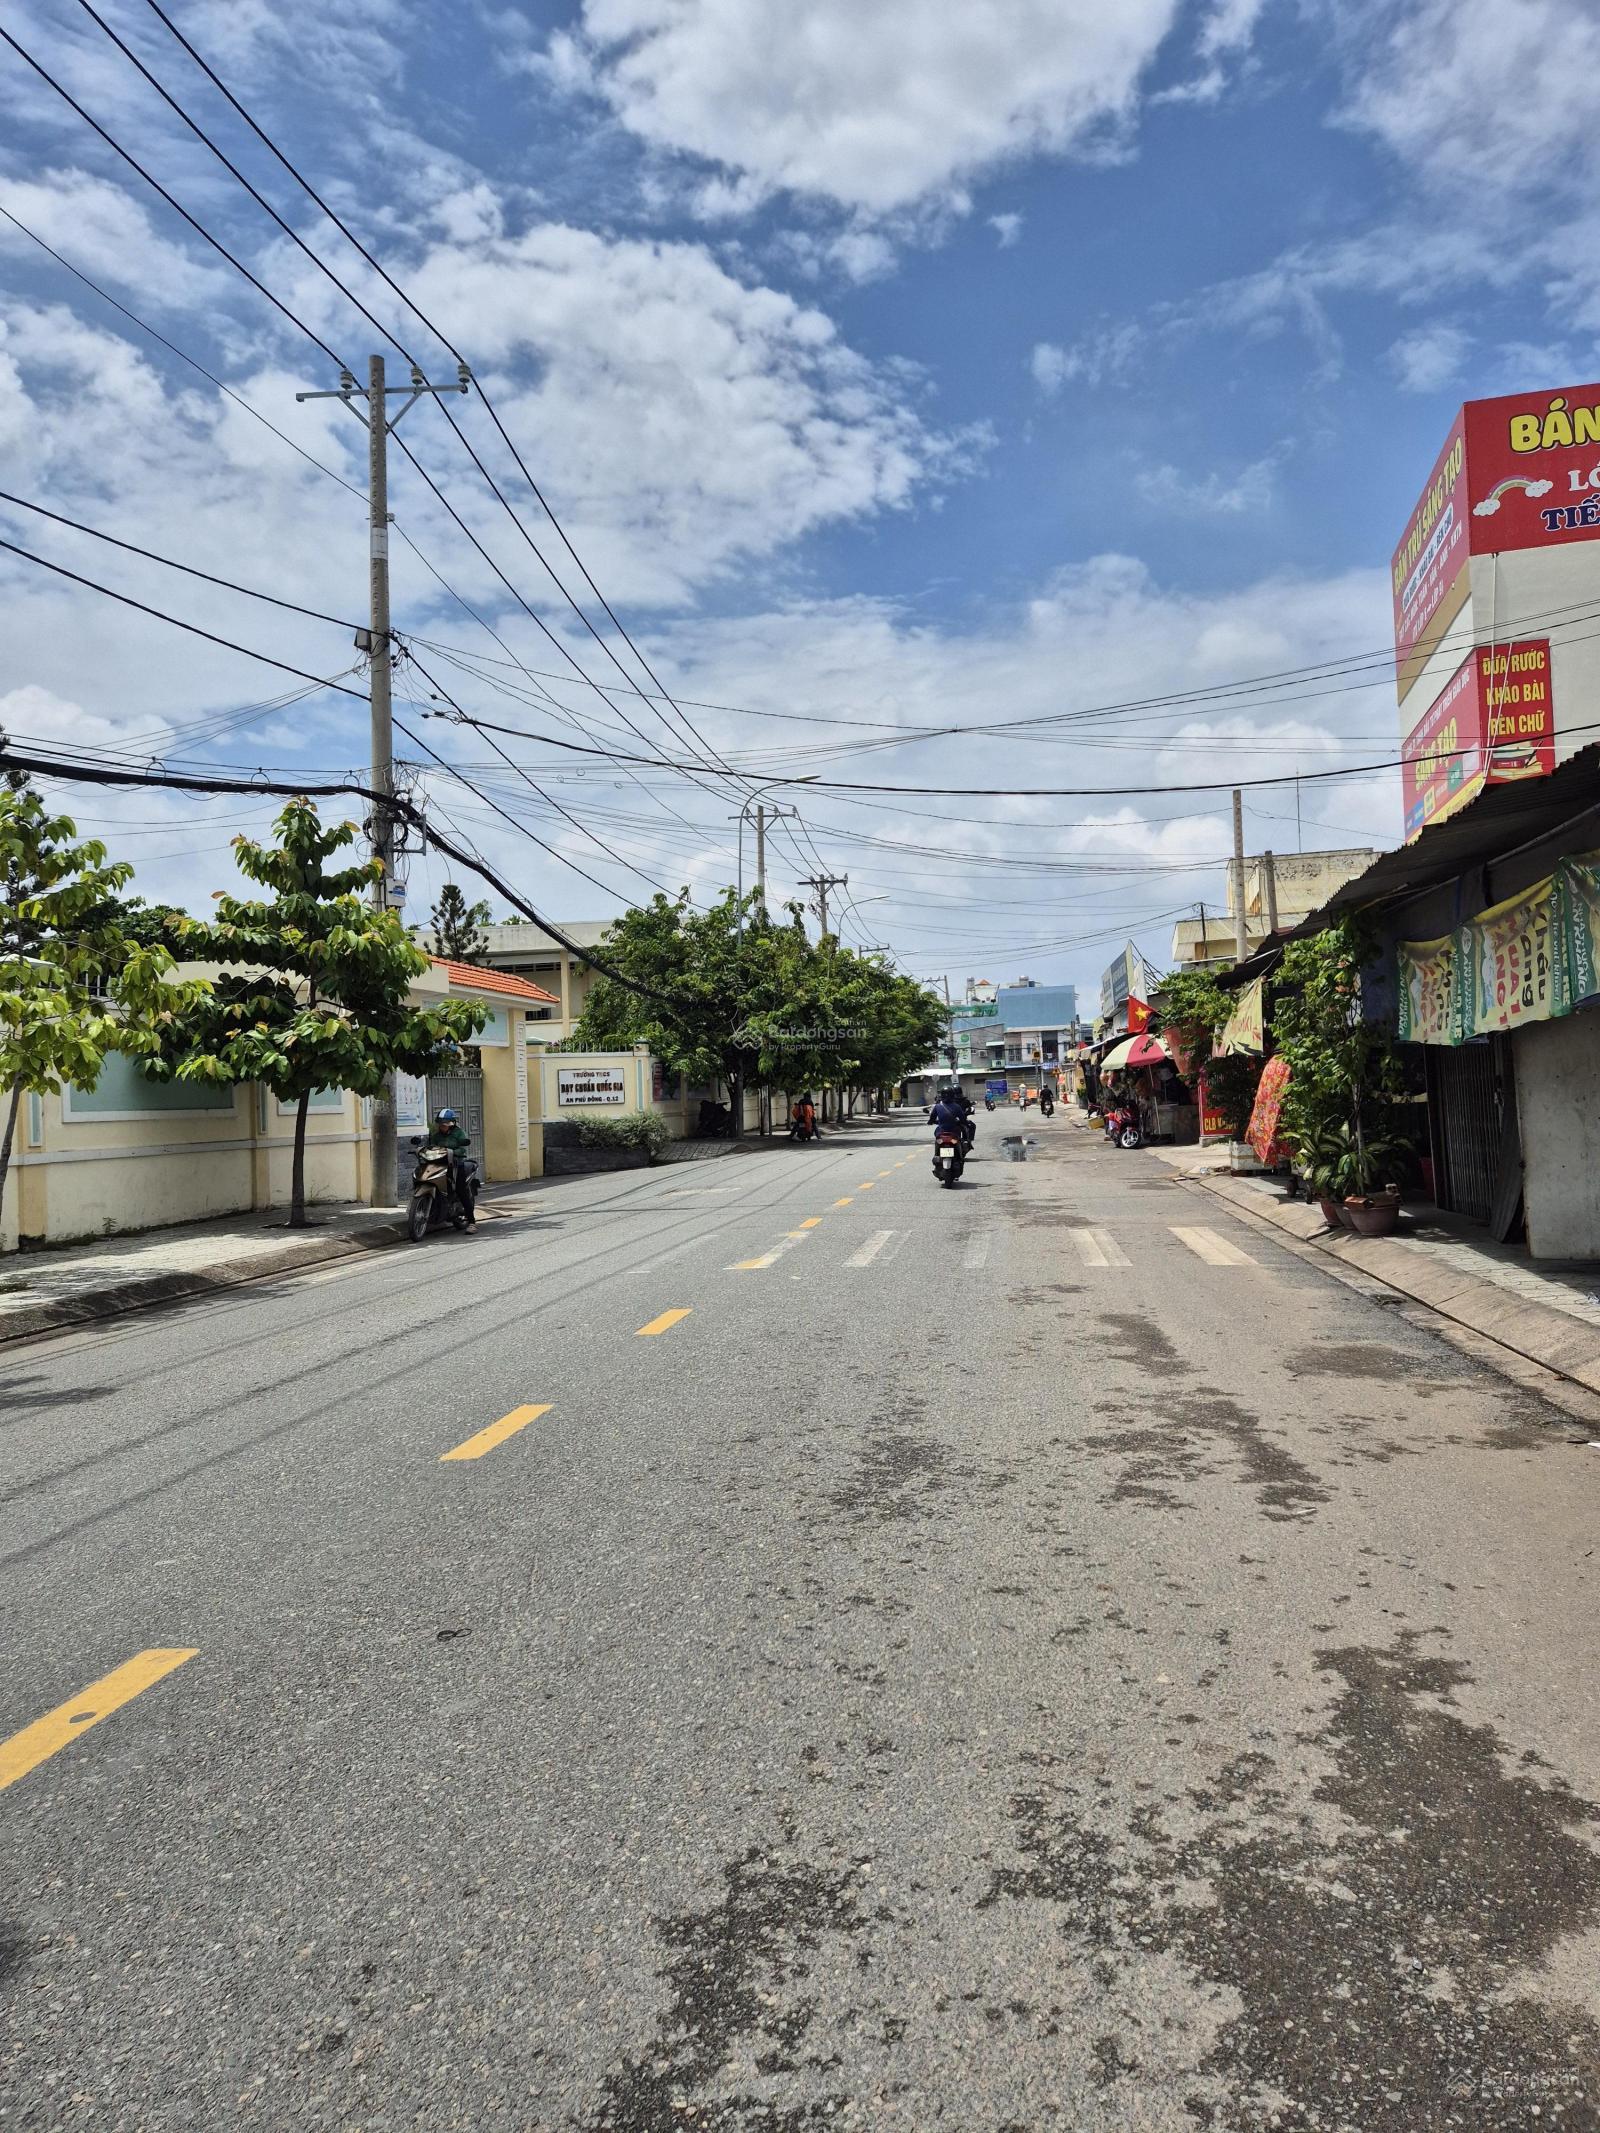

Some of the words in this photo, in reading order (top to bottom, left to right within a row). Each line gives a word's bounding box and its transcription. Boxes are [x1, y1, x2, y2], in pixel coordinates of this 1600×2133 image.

[1508, 397, 1600, 454] BÁN
[1393, 549, 1408, 596] BÁN
[1407, 509, 1422, 568] TRÚ
[1421, 474, 1443, 541] SÁNG
[1443, 434, 1462, 497] TẠO
[1482, 654, 1507, 676] ĐƯA
[1511, 649, 1545, 673] RƯỚC
[1486, 680, 1520, 706] KHẢO
[1523, 680, 1545, 702] BÀI
[1490, 714, 1516, 737] RÈN
[1518, 710, 1545, 733] CHỮ
[1437, 717, 1457, 767] TẠO
[574, 1079, 595, 1093] CHUẨN
[574, 1095, 587, 1103] PHÚ
